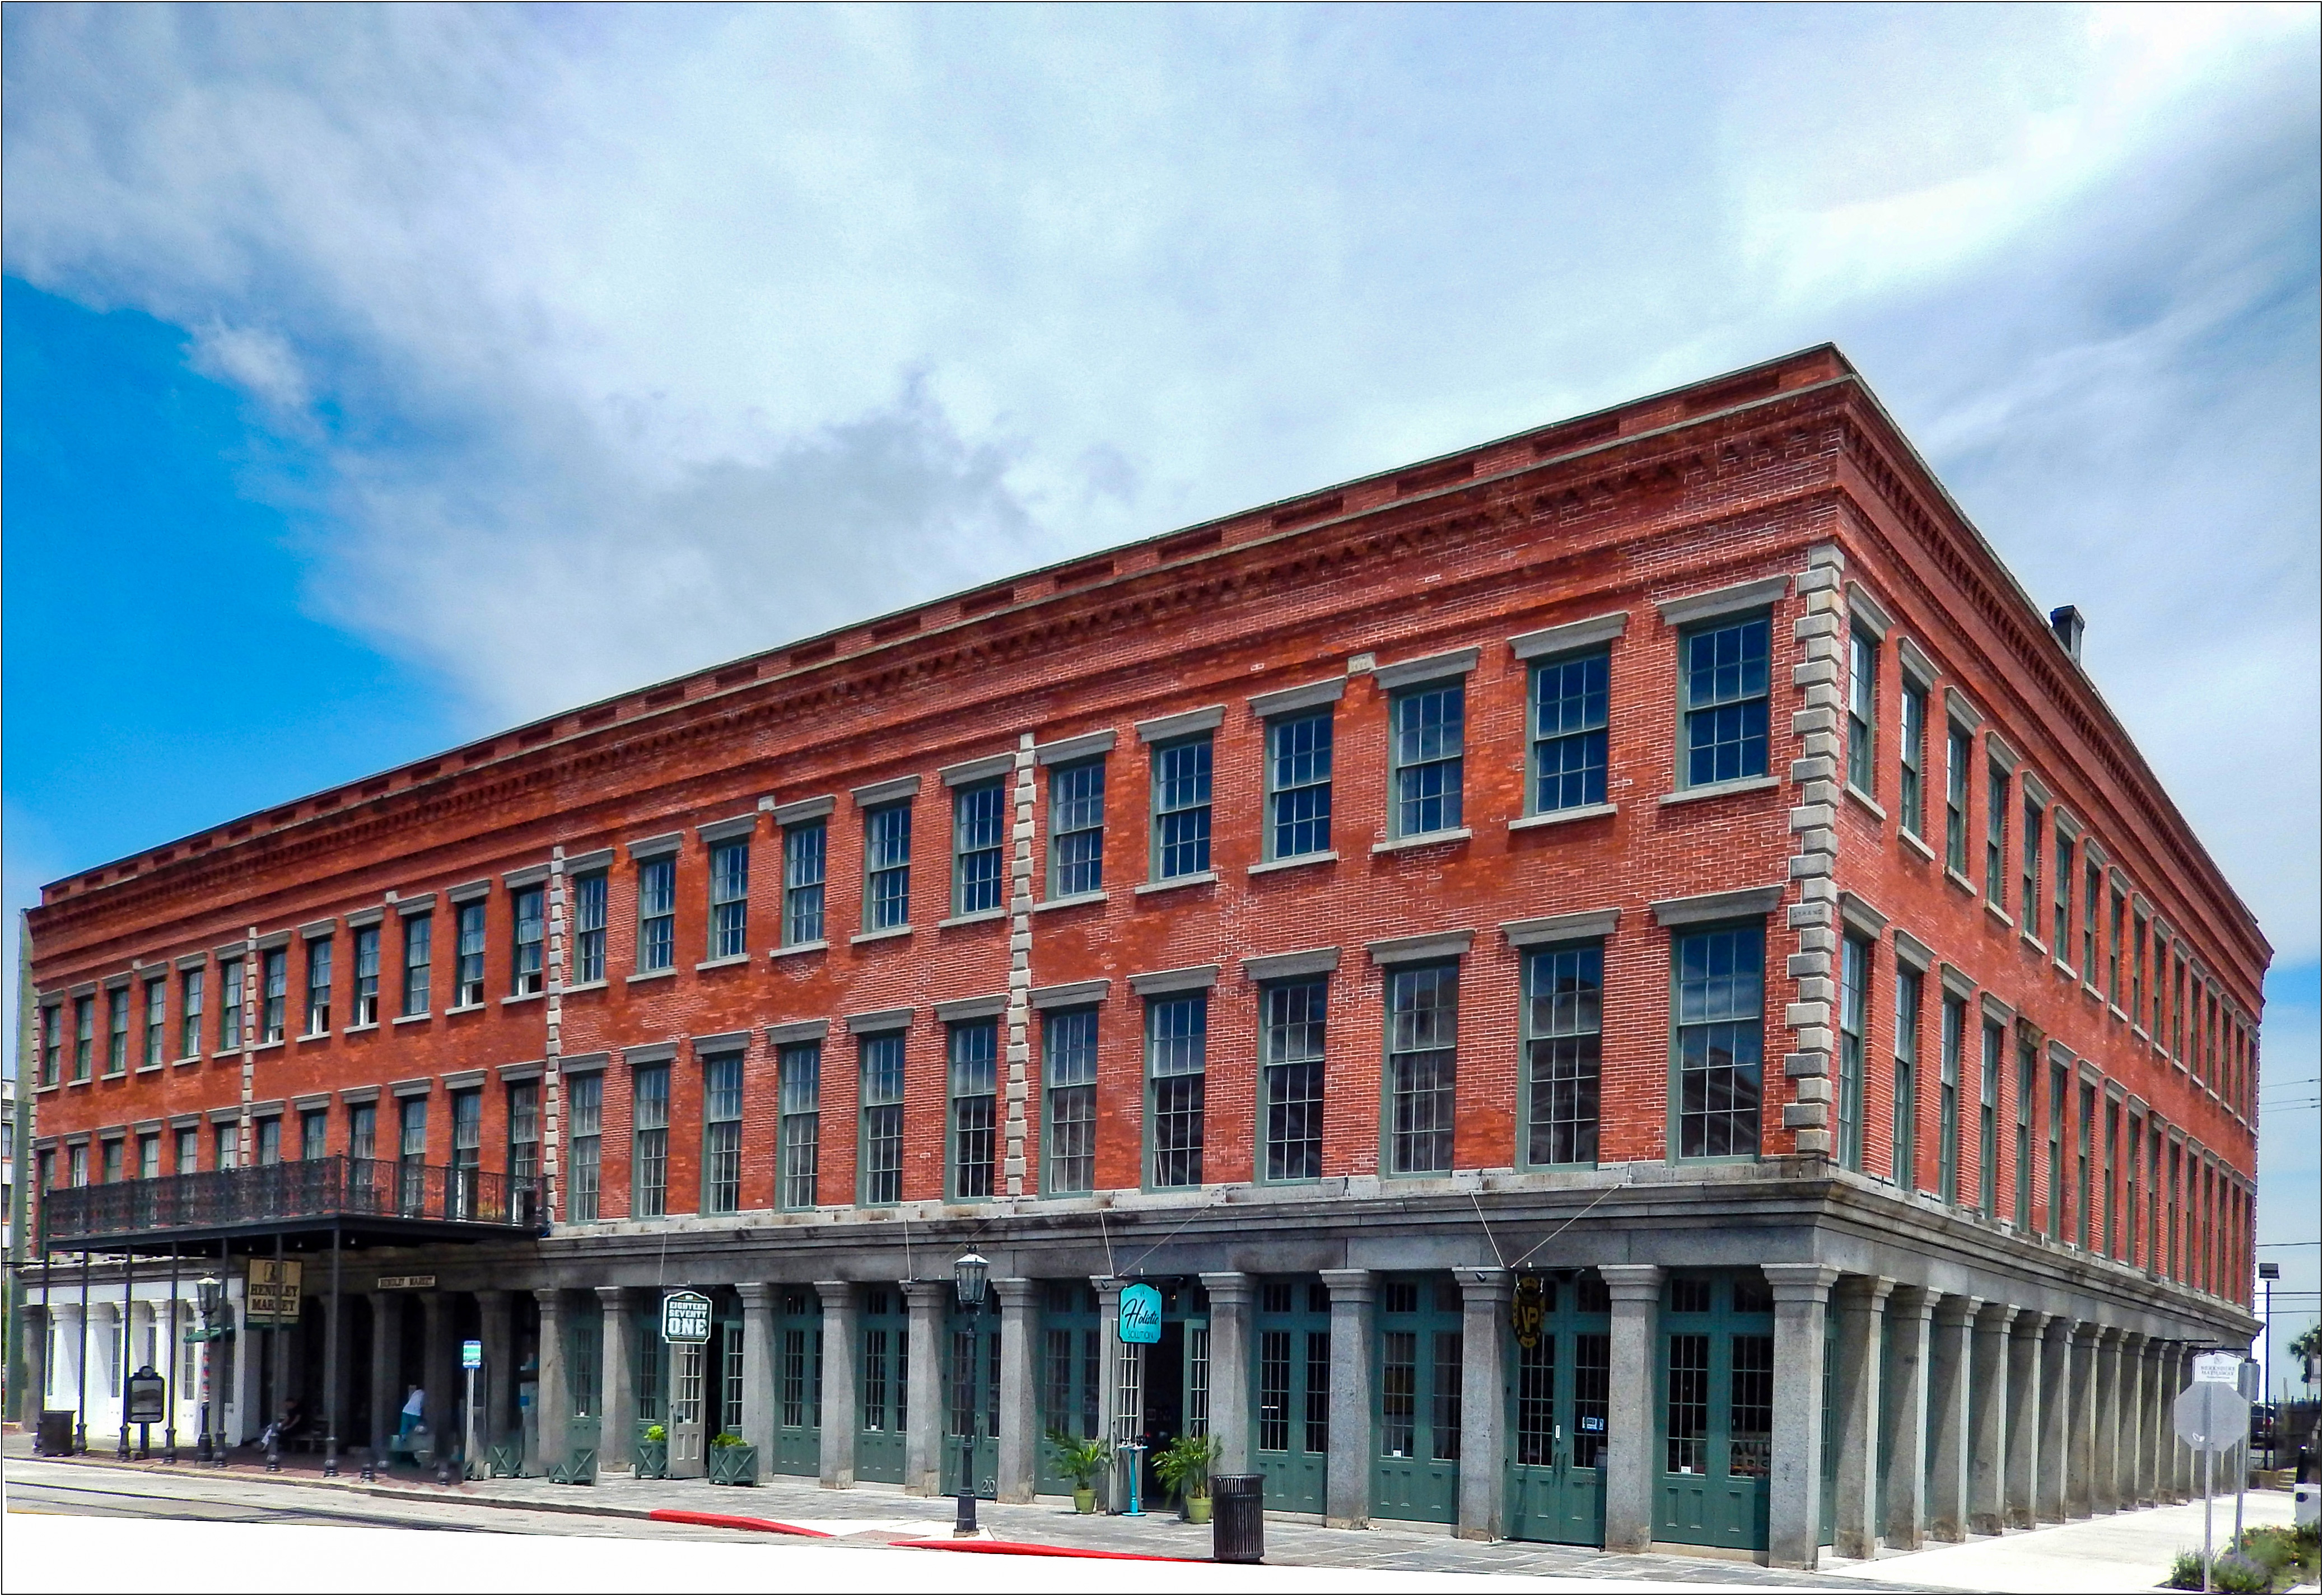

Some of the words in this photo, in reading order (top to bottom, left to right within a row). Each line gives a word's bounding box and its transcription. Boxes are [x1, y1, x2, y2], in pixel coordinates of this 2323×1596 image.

[251, 1298, 296, 1312] MARET
[669, 1301, 707, 1310] EIGHTEEN
[669, 1309, 707, 1318] SEVENTY
[1122, 1298, 1159, 1329] Holistic
[668, 1318, 707, 1336] ONE
[1127, 1330, 1154, 1340] SOLUTION
[981, 1479, 999, 1493] 20
